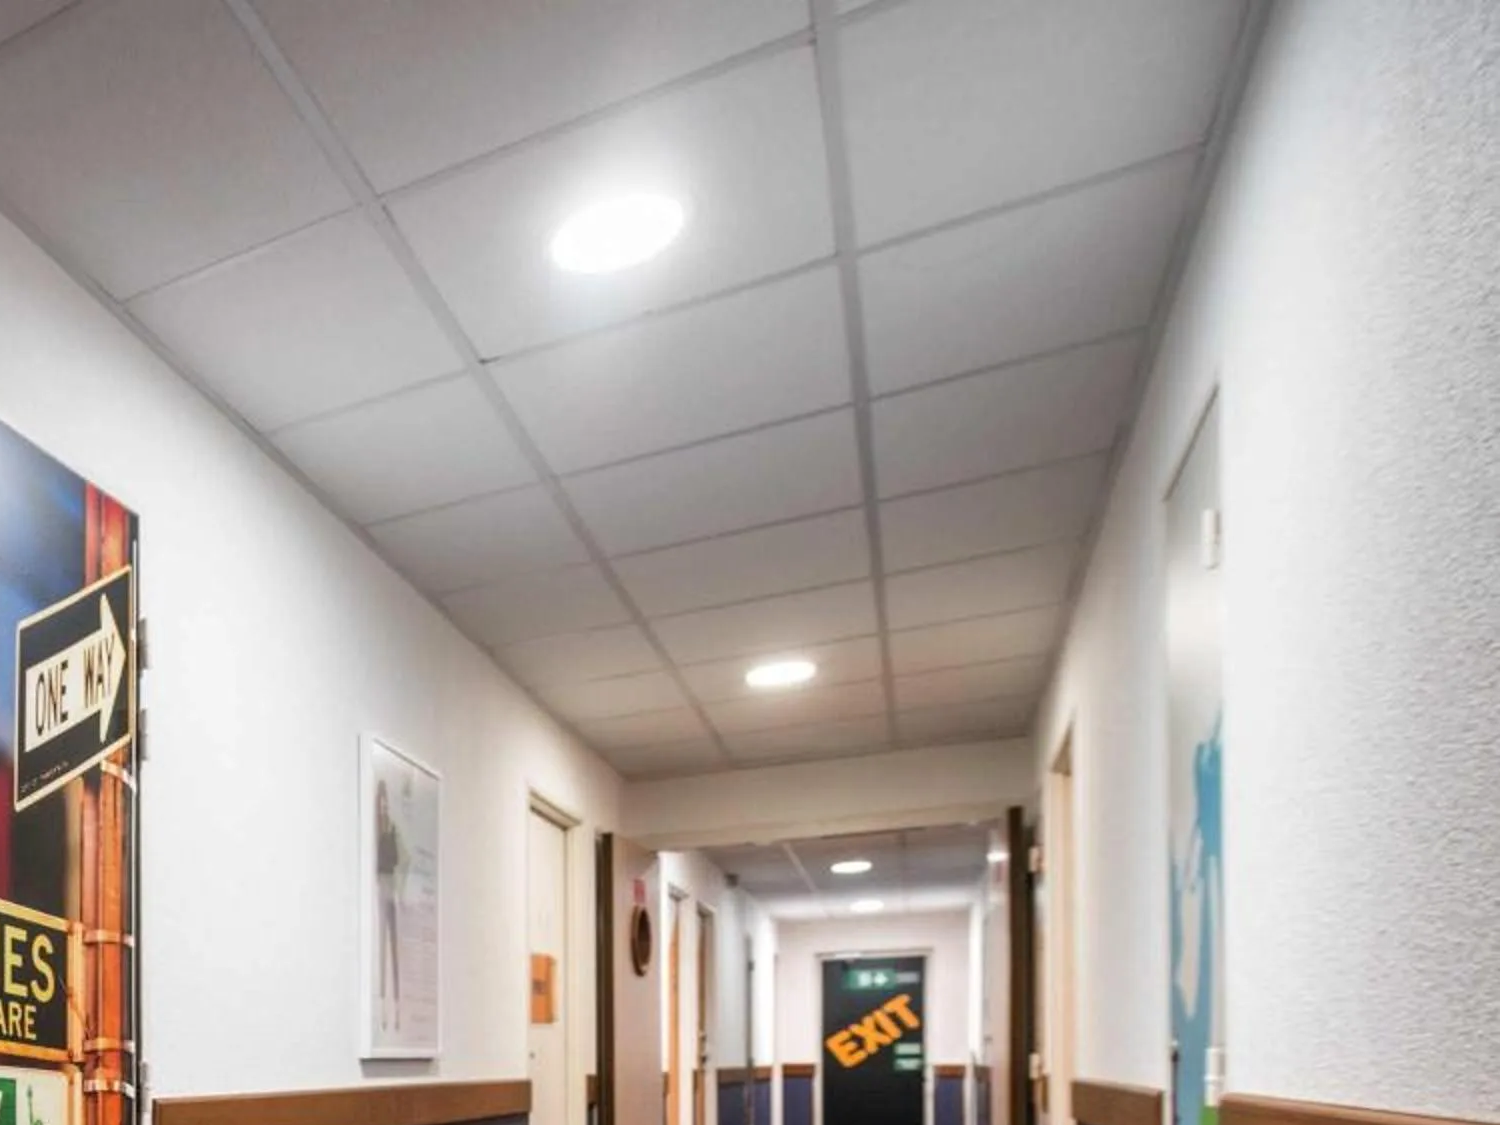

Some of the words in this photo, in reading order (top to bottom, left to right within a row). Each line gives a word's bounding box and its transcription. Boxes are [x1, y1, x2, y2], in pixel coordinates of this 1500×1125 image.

[33, 658, 69, 738] ONE
[82, 632, 116, 710] WAY
[826, 993, 920, 1068] EXIT
